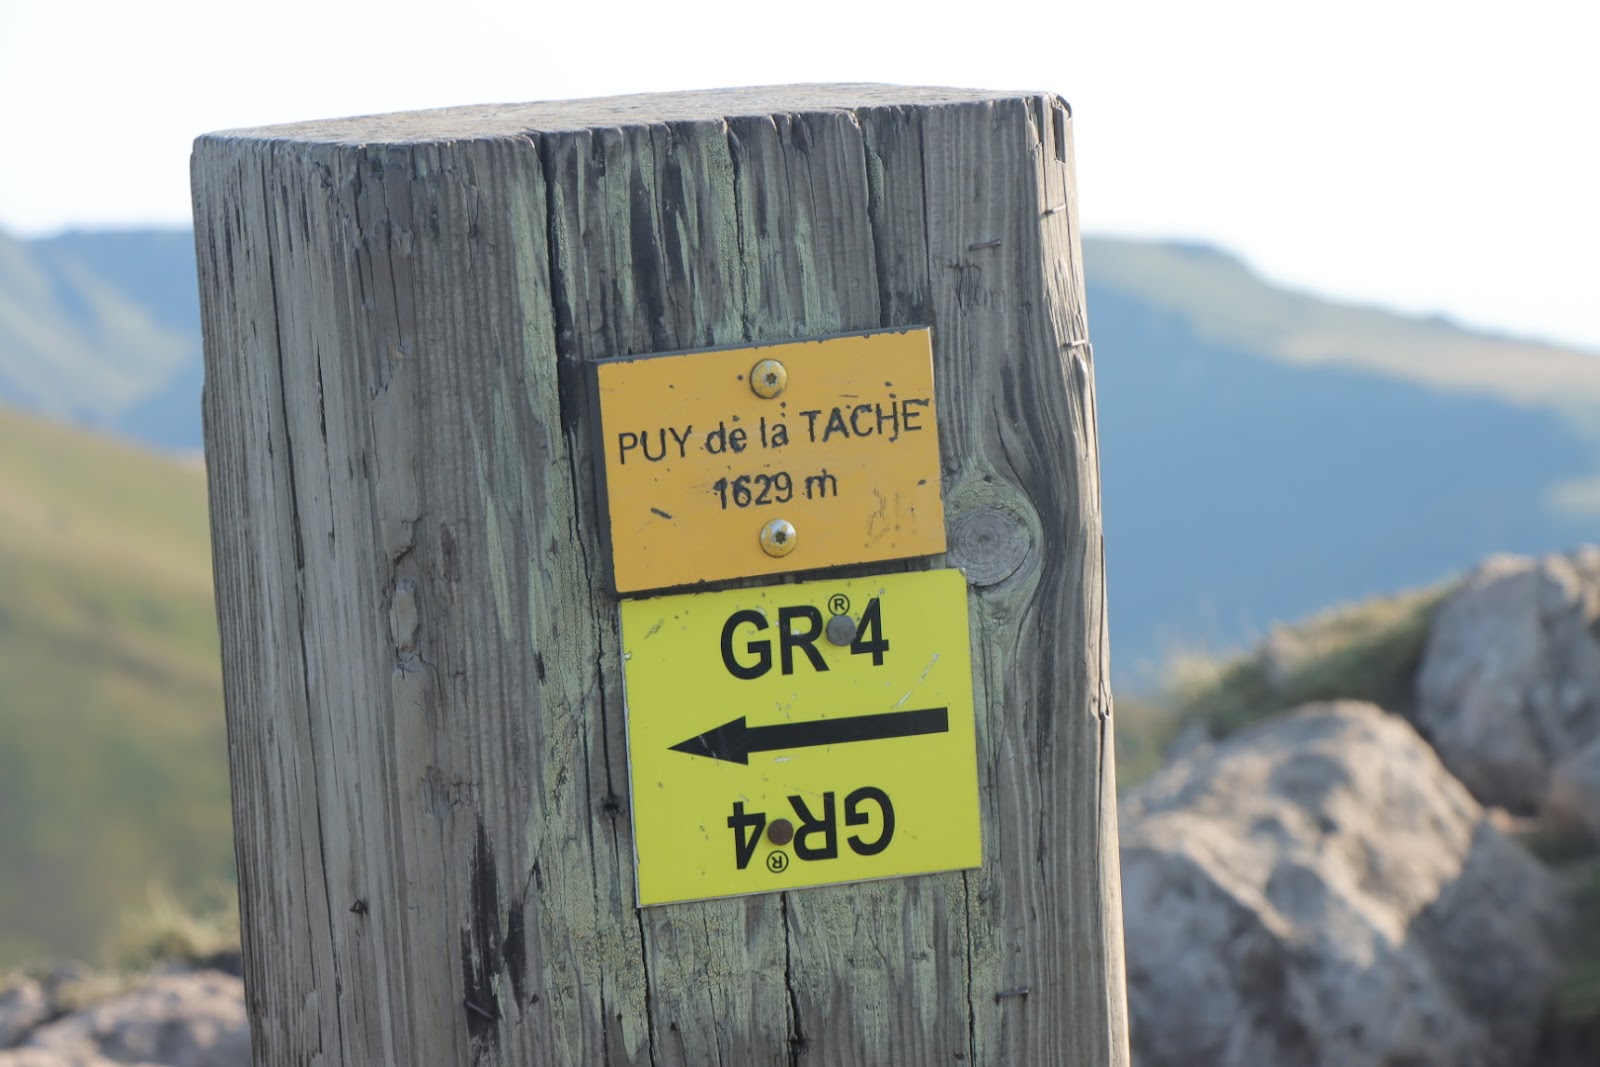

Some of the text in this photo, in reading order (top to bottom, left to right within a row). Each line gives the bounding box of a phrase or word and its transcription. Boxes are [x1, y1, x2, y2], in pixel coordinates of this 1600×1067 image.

[618, 425, 692, 465] PUY
[705, 421, 748, 454] de
[760, 416, 790, 449] la
[713, 471, 838, 511] 1629 m
